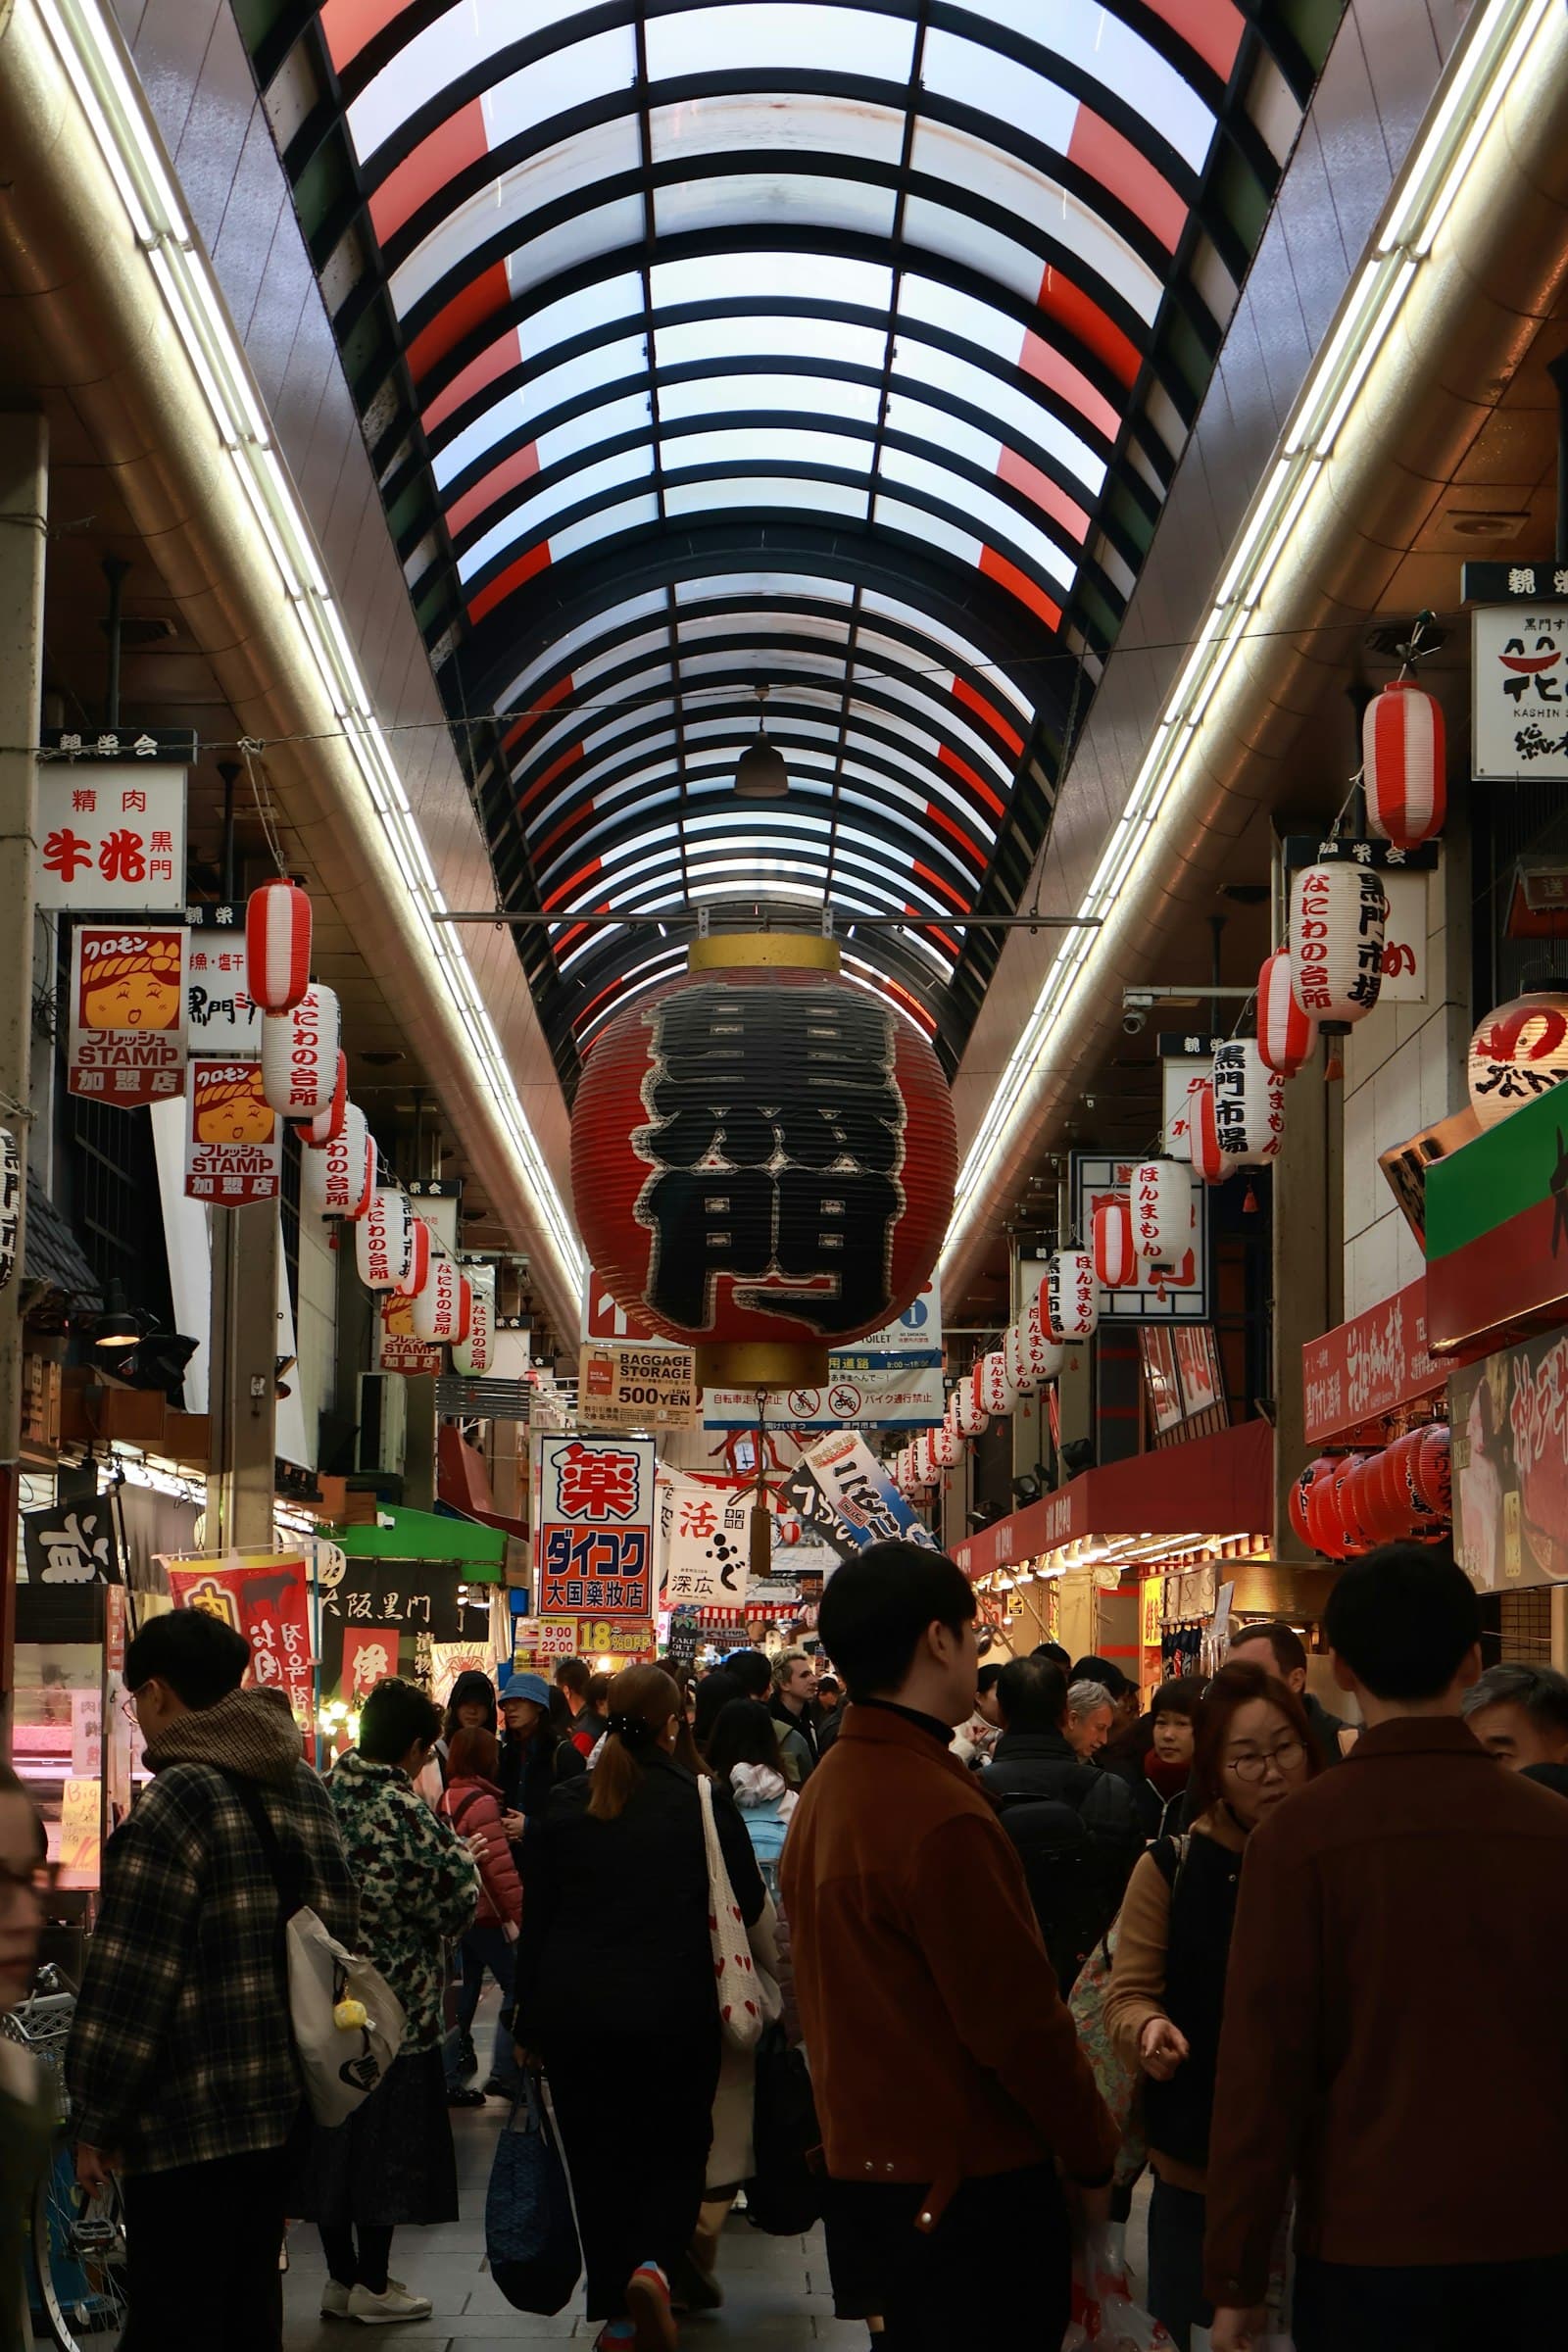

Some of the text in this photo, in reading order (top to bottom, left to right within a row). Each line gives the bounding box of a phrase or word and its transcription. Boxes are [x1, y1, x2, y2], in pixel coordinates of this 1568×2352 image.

[1524, 617, 1568, 631] 黒門す
[1514, 709, 1559, 717] KASHIN
[60, 734, 159, 756] 親栄会
[73, 789, 146, 812] 精肉
[43, 828, 145, 882] 牛兆
[149, 831, 172, 881] 黒門
[84, 936, 148, 960] クロモン
[1301, 874, 1331, 1009] なにわの台所
[87, 1030, 167, 1047] フレッシュ
[78, 1047, 177, 1065] STAMP
[78, 1070, 177, 1093] 加盟店
[197, 1066, 249, 1084] クロモン
[1214, 1045, 1250, 1154] 黒門市場
[199, 1145, 265, 1157] フレッシュ
[192, 1158, 273, 1173] STAMP
[192, 1178, 273, 1196] 加盟店
[1140, 1166, 1162, 1257] ほんまもん
[433, 1263, 453, 1336] なにわの台所
[1074, 1255, 1094, 1334] ほんまもん
[469, 1304, 488, 1370] なにわの台所
[861, 1335, 891, 1344] TOILET
[384, 1344, 437, 1354] STAMP
[620, 1353, 692, 1367] BAGGAGE
[620, 1365, 691, 1380] STORAGE
[991, 1356, 1005, 1411] ほんまもん
[865, 1393, 934, 1405] バイク通行禁止
[552, 1443, 640, 1520] 薬
[679, 1500, 718, 1539] 活
[547, 1529, 645, 1577] ダイコク
[706, 1533, 745, 1592] ふぐ
[671, 1575, 714, 1594] 深広
[545, 1627, 571, 1638] 9:00
[671, 1636, 695, 1645] TAKE
[541, 1642, 573, 1652] 22:00
